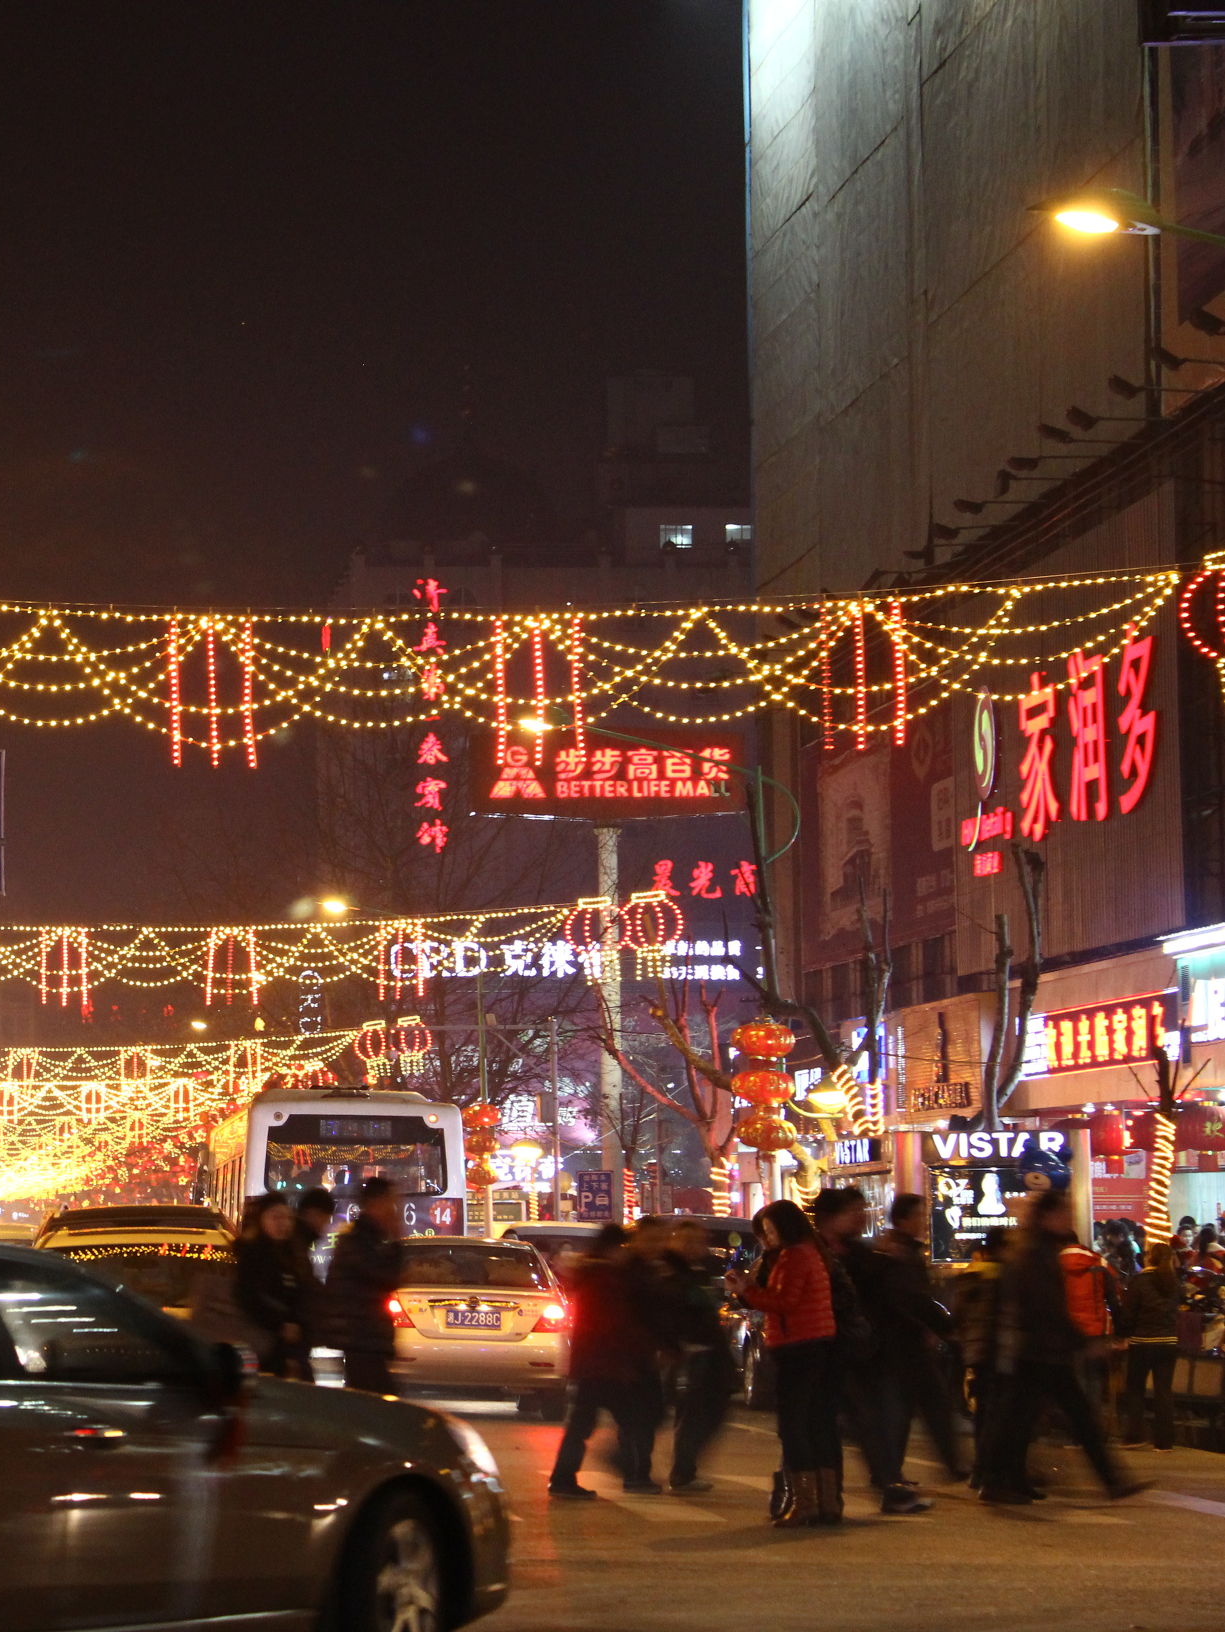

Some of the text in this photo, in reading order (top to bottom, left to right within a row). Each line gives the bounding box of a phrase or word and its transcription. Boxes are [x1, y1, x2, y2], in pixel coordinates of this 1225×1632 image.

[1018, 625, 1157, 842] 家润多
[555, 747, 732, 780] 步步高百货
[555, 781, 731, 798] BETTER LIFE MALL
[581, 1192, 593, 1211] P
[433, 1207, 452, 1225] 14
